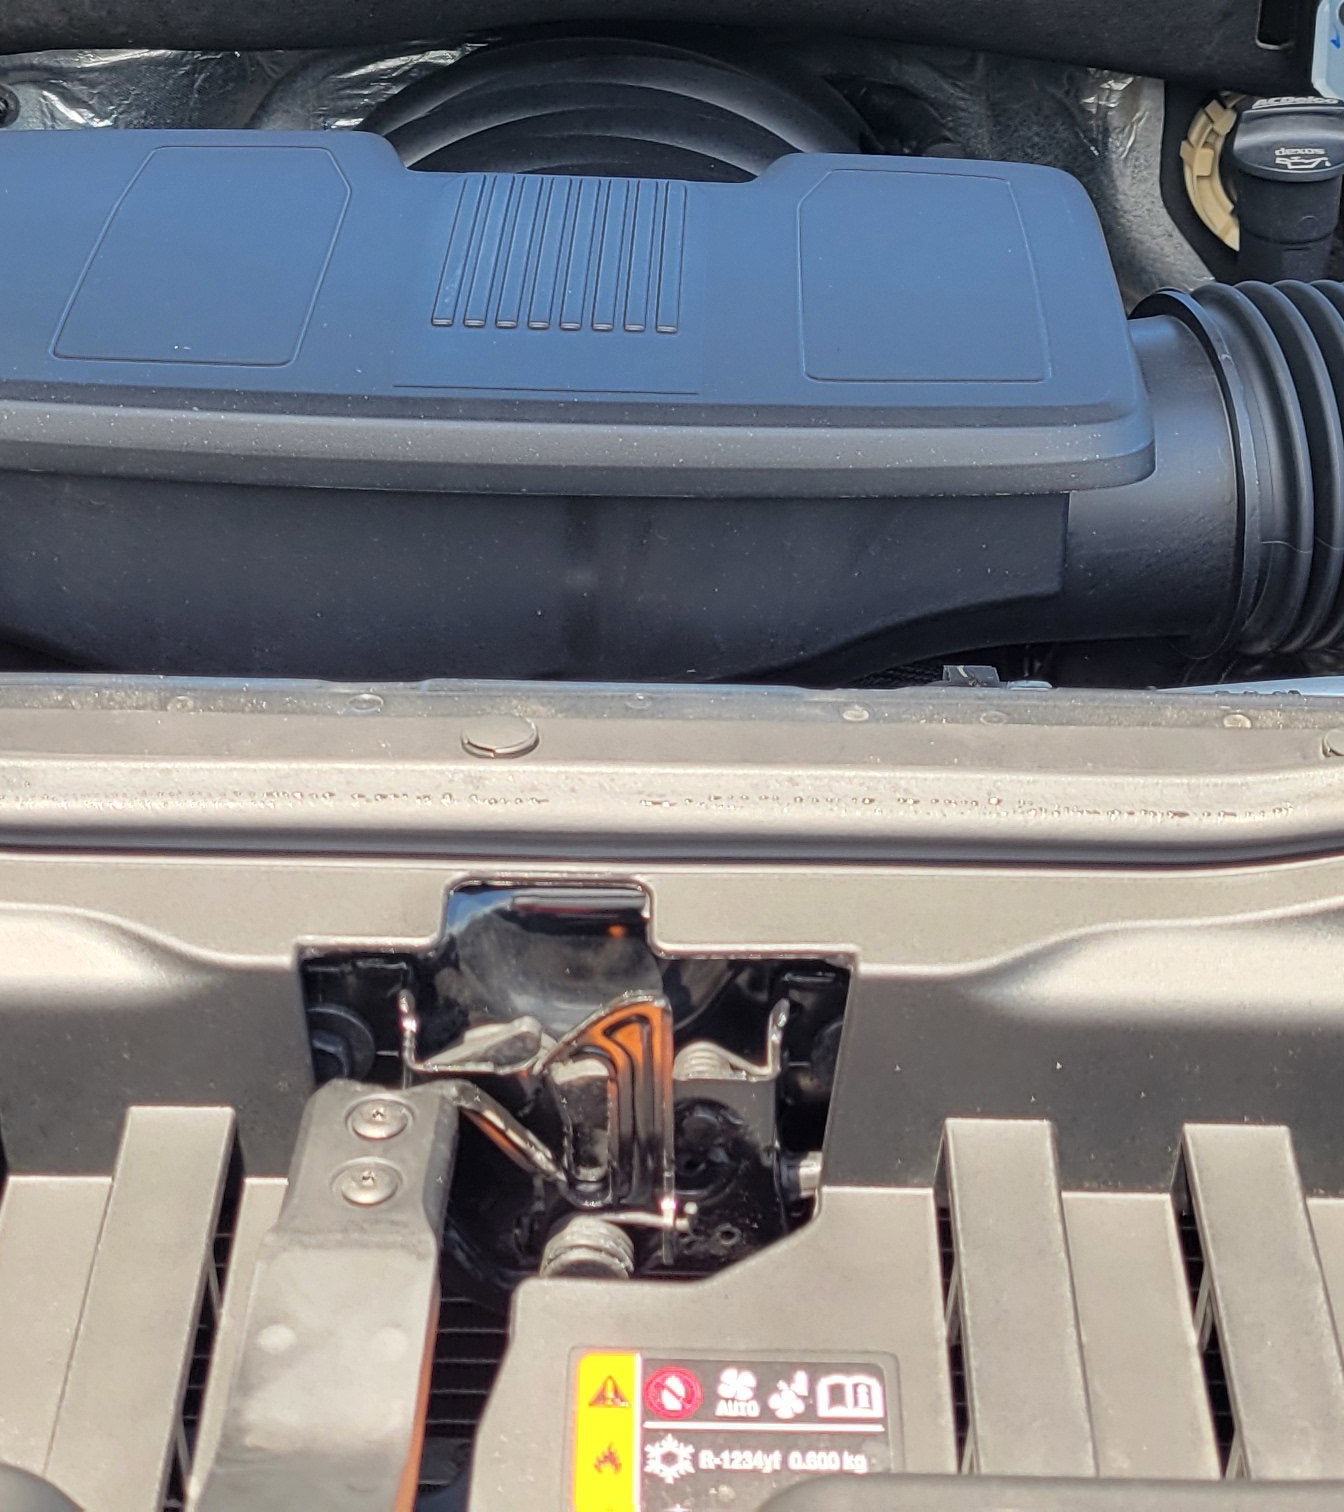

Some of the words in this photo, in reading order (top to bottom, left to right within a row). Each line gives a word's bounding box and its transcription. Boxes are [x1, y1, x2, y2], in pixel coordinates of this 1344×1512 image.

[1252, 96, 1339, 109] ACDelco
[1275, 148, 1325, 156] dexos
[715, 1400, 760, 1417] AUTO
[699, 1449, 782, 1473] R-1234yf
[788, 1450, 841, 1471] 0.600
[842, 1450, 868, 1474] kg
